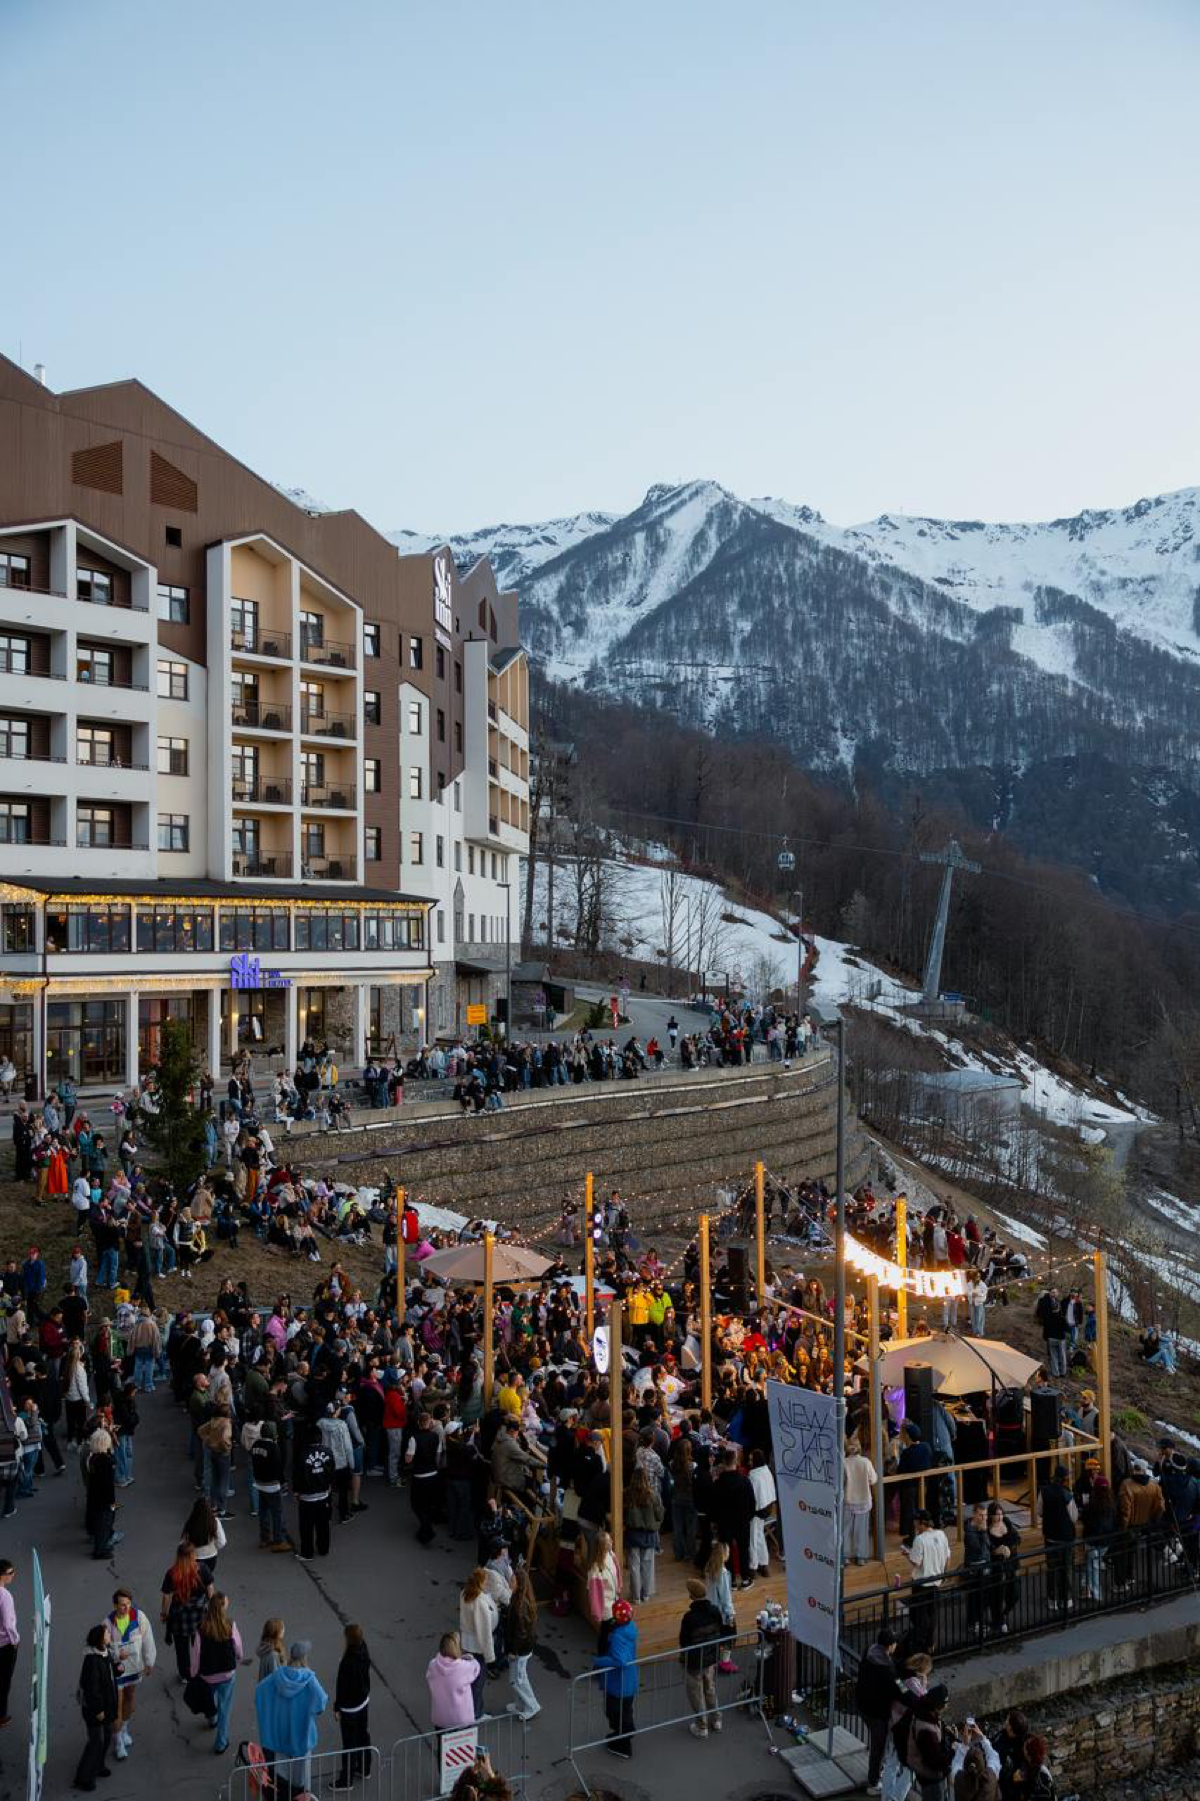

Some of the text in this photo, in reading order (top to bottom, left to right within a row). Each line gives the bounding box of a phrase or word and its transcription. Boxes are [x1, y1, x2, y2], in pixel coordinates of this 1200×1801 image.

[434, 556, 451, 606] Ski
[230, 953, 259, 974] Ski
[777, 1396, 831, 1432] NEW
[779, 1421, 834, 1459] STAR
